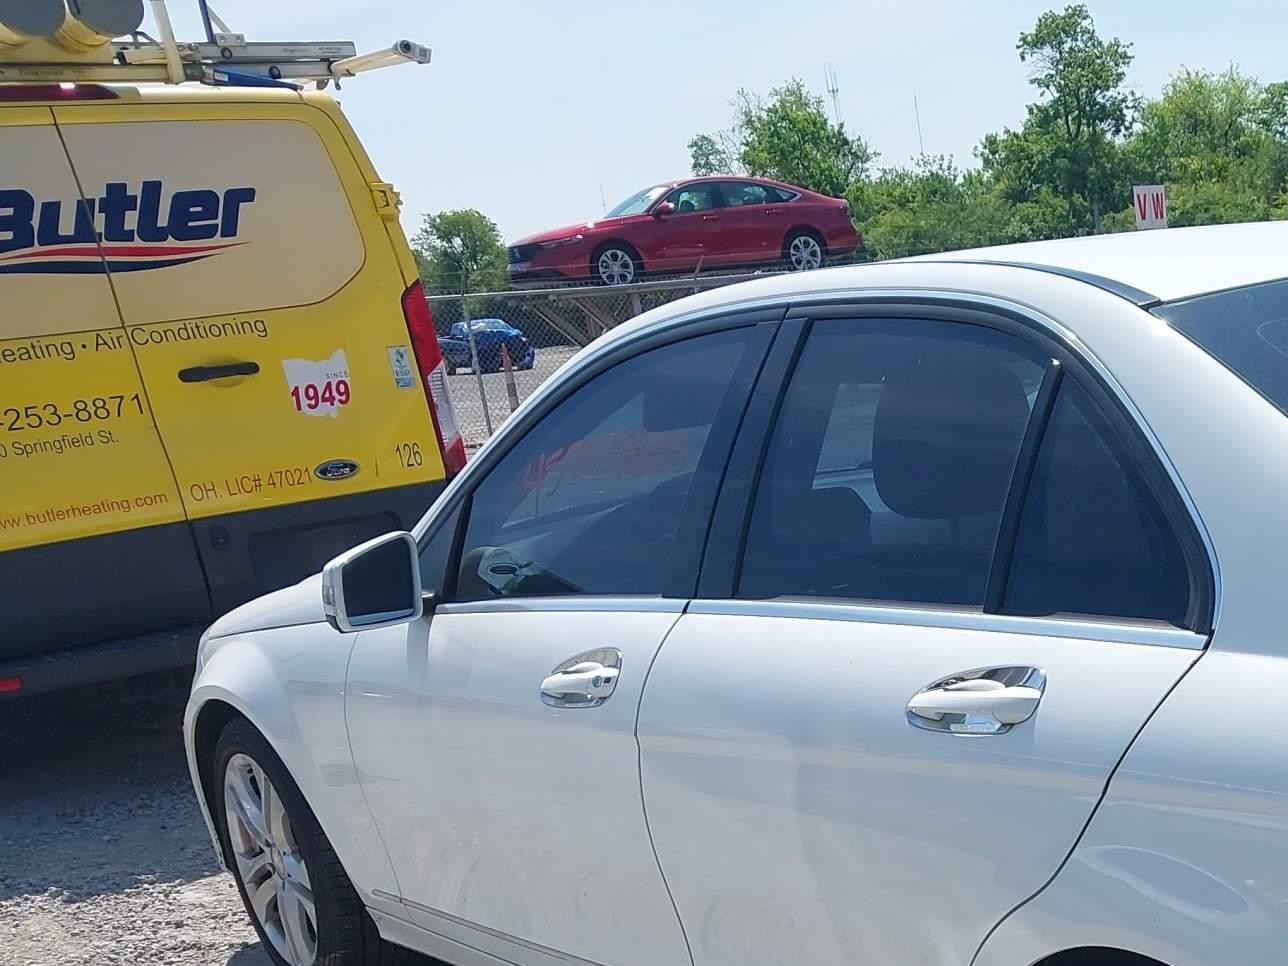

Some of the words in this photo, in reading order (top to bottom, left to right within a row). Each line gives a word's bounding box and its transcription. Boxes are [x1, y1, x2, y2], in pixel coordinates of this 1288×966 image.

[0, 180, 256, 253] Butler
[0, 340, 75, 363] eating
[95, 332, 124, 351] Air
[131, 317, 267, 347] Conditioning
[325, 370, 349, 379] SINCE
[291, 380, 350, 411] 1949
[11, 432, 95, 457] Springfield
[97, 429, 119, 444] St.
[395, 442, 423, 469] 126
[190, 483, 222, 502] OH.
[225, 475, 263, 497] LIC#
[267, 467, 313, 488] 47021
